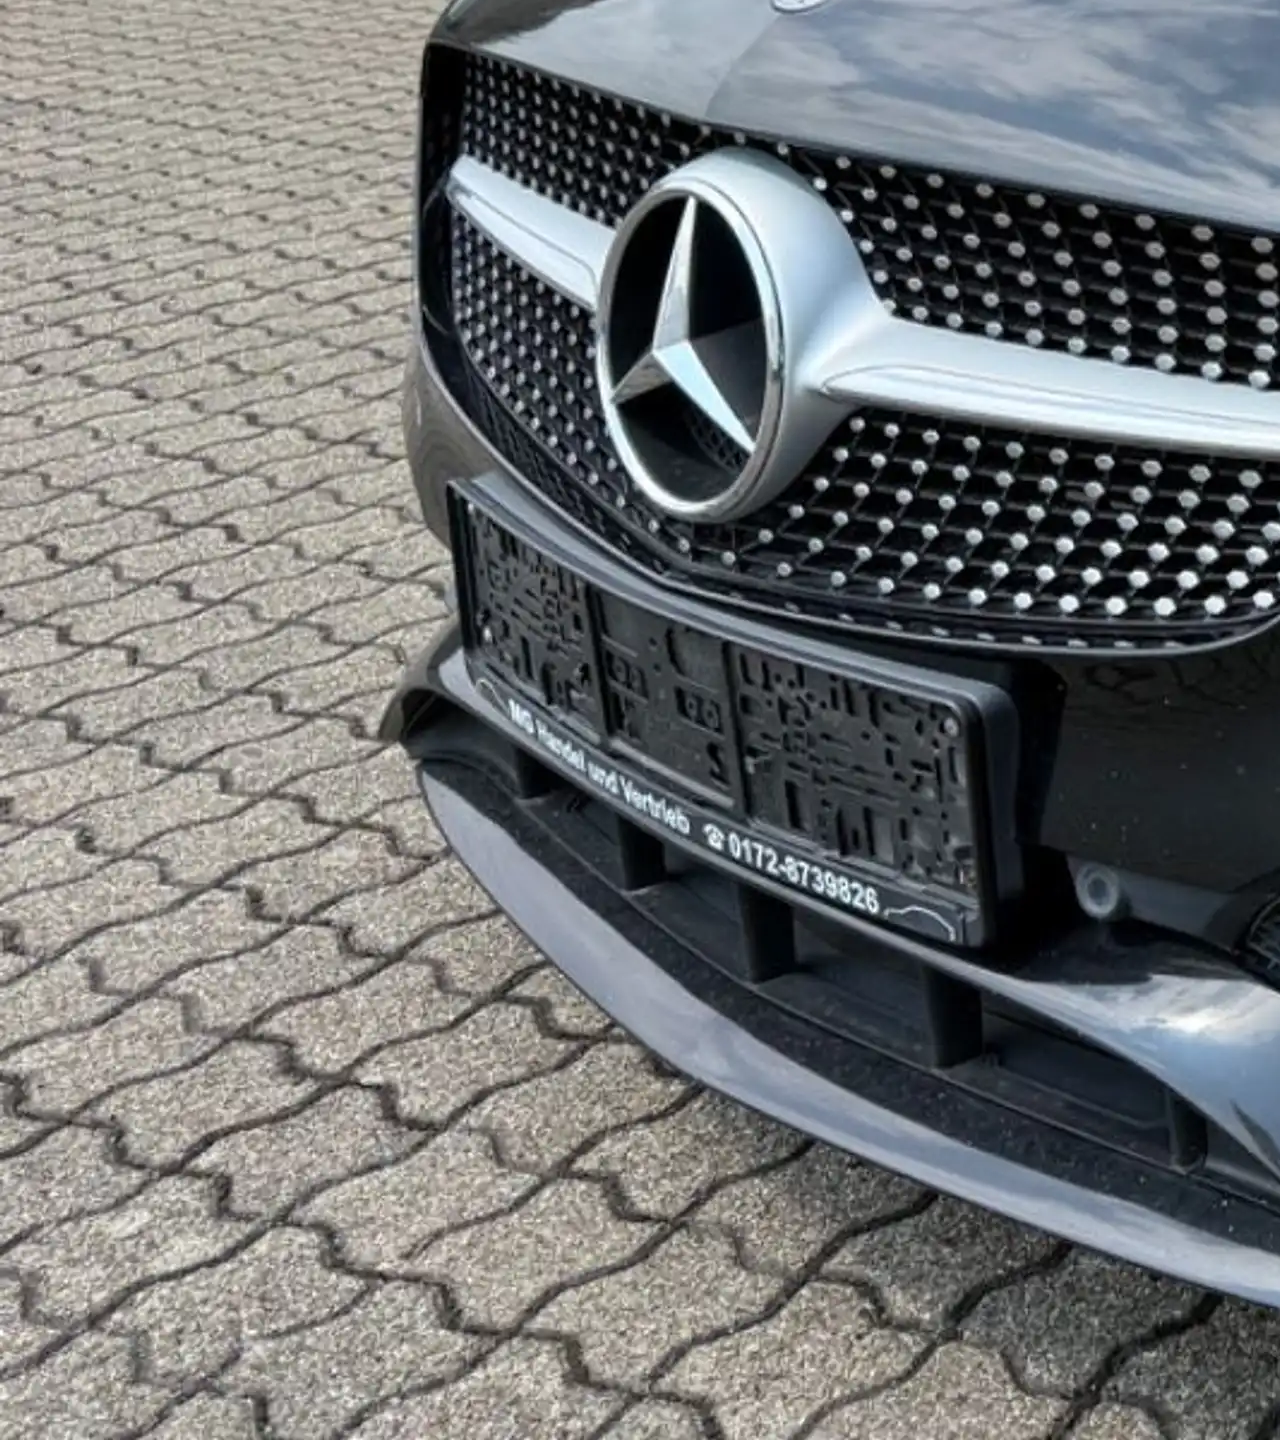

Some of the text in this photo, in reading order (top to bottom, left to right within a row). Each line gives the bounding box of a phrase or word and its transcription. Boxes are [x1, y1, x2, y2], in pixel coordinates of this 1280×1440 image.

[535, 719, 587, 773] Handel
[587, 761, 620, 795] und
[619, 773, 691, 835] Vertrieb
[727, 831, 881, 915] 0172-8739826
